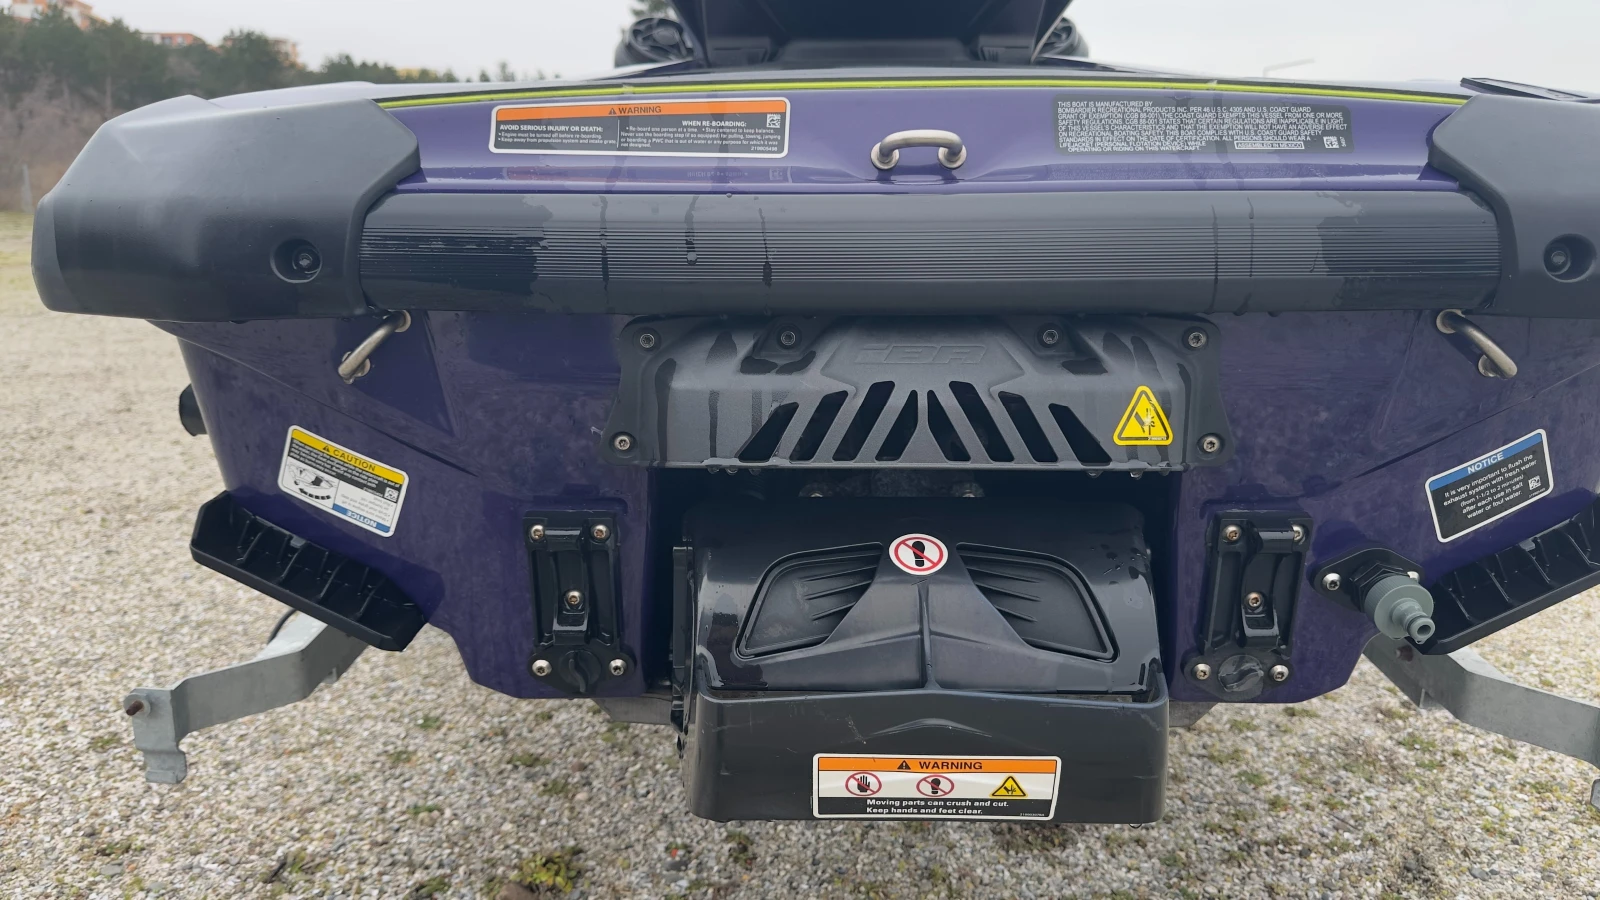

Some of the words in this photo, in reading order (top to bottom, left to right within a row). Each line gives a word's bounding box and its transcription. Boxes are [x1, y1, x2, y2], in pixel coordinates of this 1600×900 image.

[618, 106, 661, 114] WARNING
[332, 447, 375, 472] CAUTION
[1467, 452, 1504, 474] NOTICE
[1442, 490, 1467, 506] exhaust
[1468, 480, 1490, 496] system
[1490, 474, 1503, 484] with
[1504, 467, 1520, 478] fresh
[1520, 459, 1536, 471] water
[1456, 482, 1471, 494] very
[1470, 468, 1500, 487] important
[1507, 458, 1522, 469] flush
[1523, 454, 1533, 462] the
[1460, 496, 1475, 508] (from
[1475, 489, 1490, 500] 1-1/2
[1500, 474, 1524, 490] minutes)
[1462, 503, 1476, 514] after
[1476, 496, 1492, 507] each
[1493, 491, 1504, 500] use
[1512, 482, 1523, 491] salt
[346, 510, 378, 528] NOTICE
[1466, 507, 1484, 519] water
[1492, 498, 1504, 508] foul
[918, 761, 982, 770] WARNING
[866, 799, 899, 807] Moving
[902, 800, 924, 808] parts
[866, 807, 888, 815] Keep
